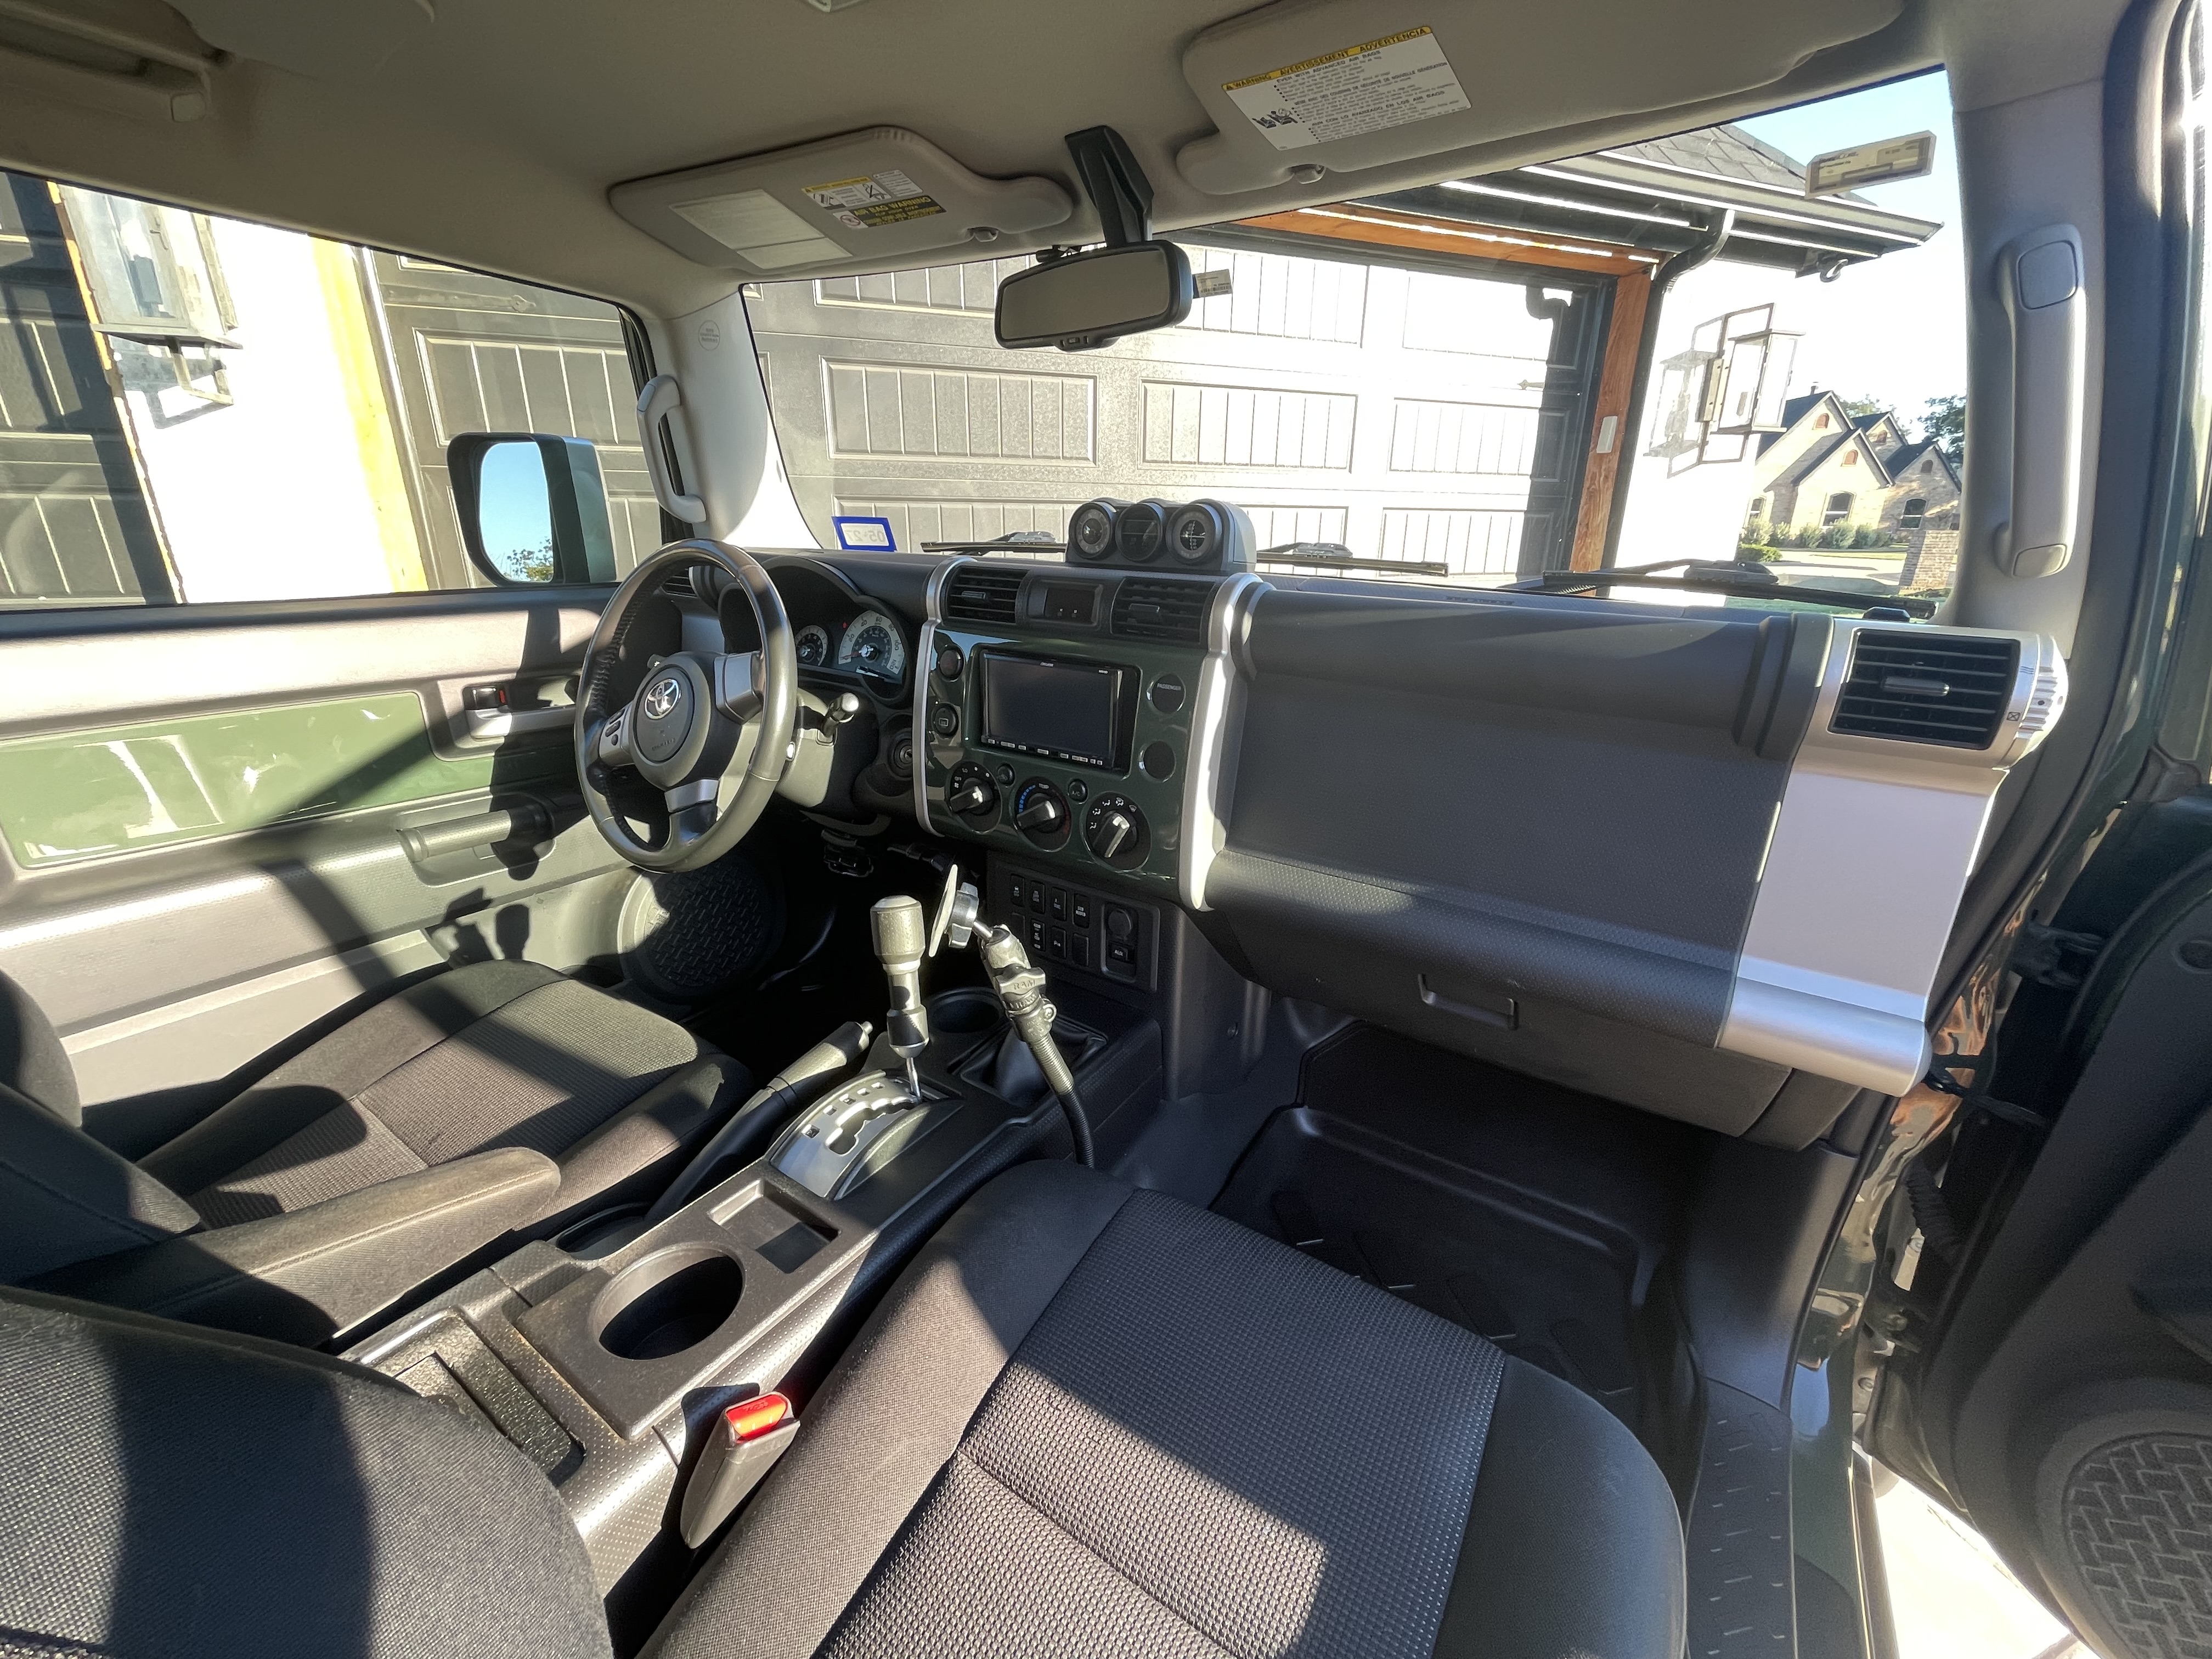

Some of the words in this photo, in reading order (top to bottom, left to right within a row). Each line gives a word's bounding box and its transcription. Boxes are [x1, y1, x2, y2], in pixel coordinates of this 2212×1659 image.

[1233, 75, 1272, 87] WARNING
[1280, 50, 1350, 76] AVERTISSEMENT
[1359, 28, 1426, 52] ADVERTENCIA
[888, 197, 932, 209] WARNING
[849, 633, 855, 642] 20
[1157, 682, 1182, 691] PASSENGER
[1013, 979, 1035, 990] RAM
